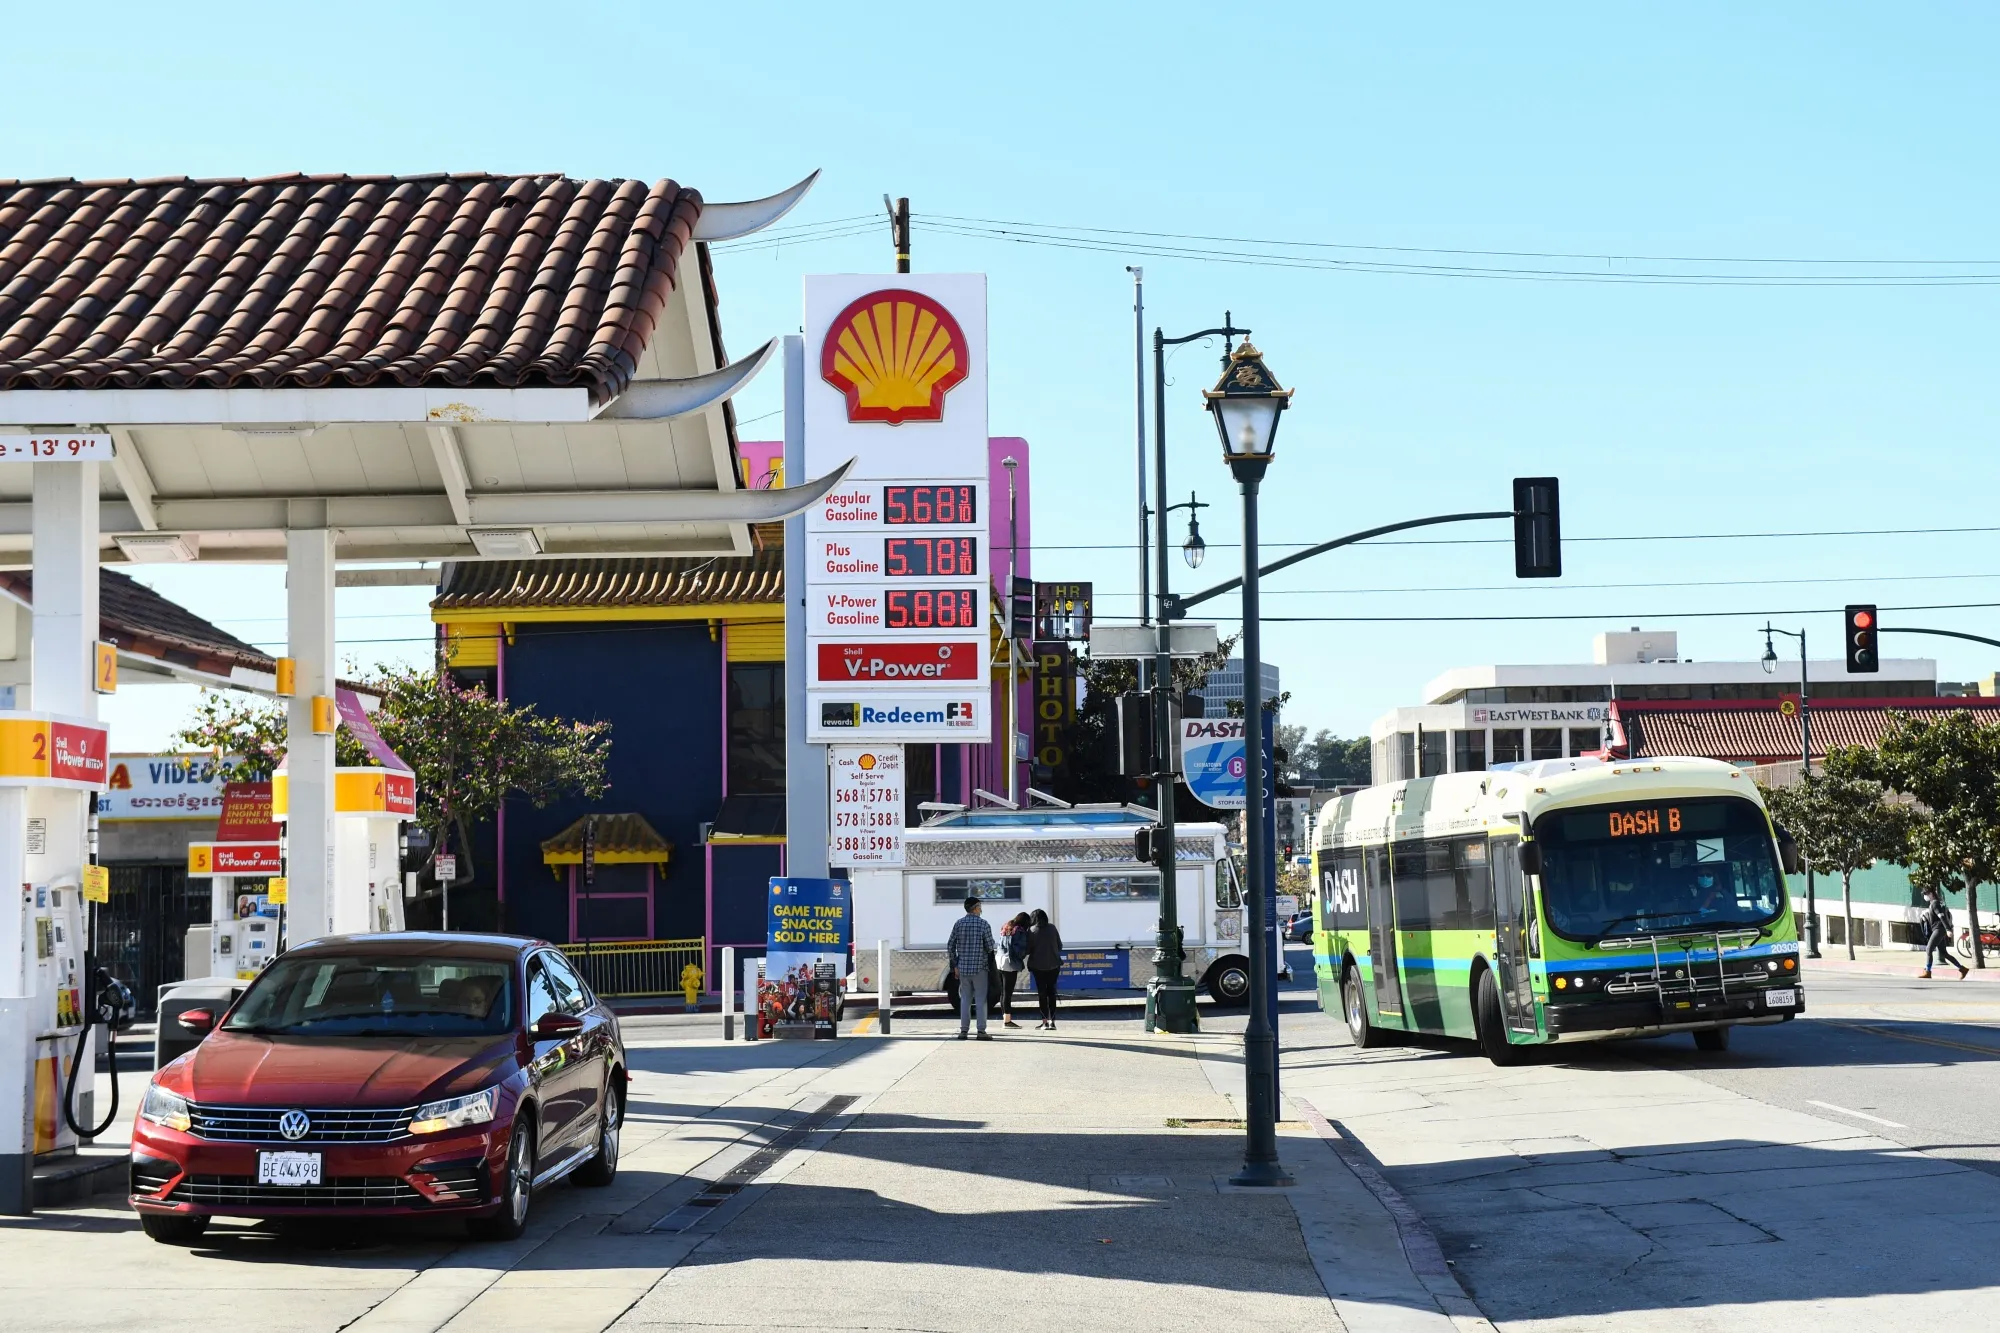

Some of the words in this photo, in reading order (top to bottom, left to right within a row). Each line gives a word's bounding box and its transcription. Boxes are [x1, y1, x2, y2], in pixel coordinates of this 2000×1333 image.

[826, 508, 878, 521] Gasoline
[826, 543, 850, 556] Plus
[826, 560, 878, 573] Gasoline
[828, 595, 877, 608] V-Power
[827, 612, 880, 624] Gasoline
[104, 654, 112, 682] 2
[844, 658, 947, 677] V-Power
[863, 707, 944, 722] Redeem
[1040, 654, 1062, 766] PHOTO
[32, 733, 46, 760] 2
[56, 737, 67, 748] Shell
[56, 749, 84, 767] V-Power
[1234, 761, 1242, 773] B
[375, 782, 383, 800] 4
[837, 789, 858, 802] 568
[870, 789, 891, 802] 578
[837, 813, 858, 826] 578
[870, 813, 891, 826] 588
[1609, 809, 1659, 837] DASH
[1668, 808, 1681, 832] B
[837, 837, 858, 850] 588
[870, 837, 891, 850] 598
[198, 855, 206, 867] 5
[1324, 869, 1359, 914] DASH
[773, 905, 810, 916] GAME
[814, 906, 843, 918] TIME
[781, 918, 833, 930] SNACKS
[774, 932, 805, 942] SOLD
[809, 933, 840, 944] HERE
[1771, 942, 1798, 954] 20309
[263, 1163, 318, 1177] BE44X98
